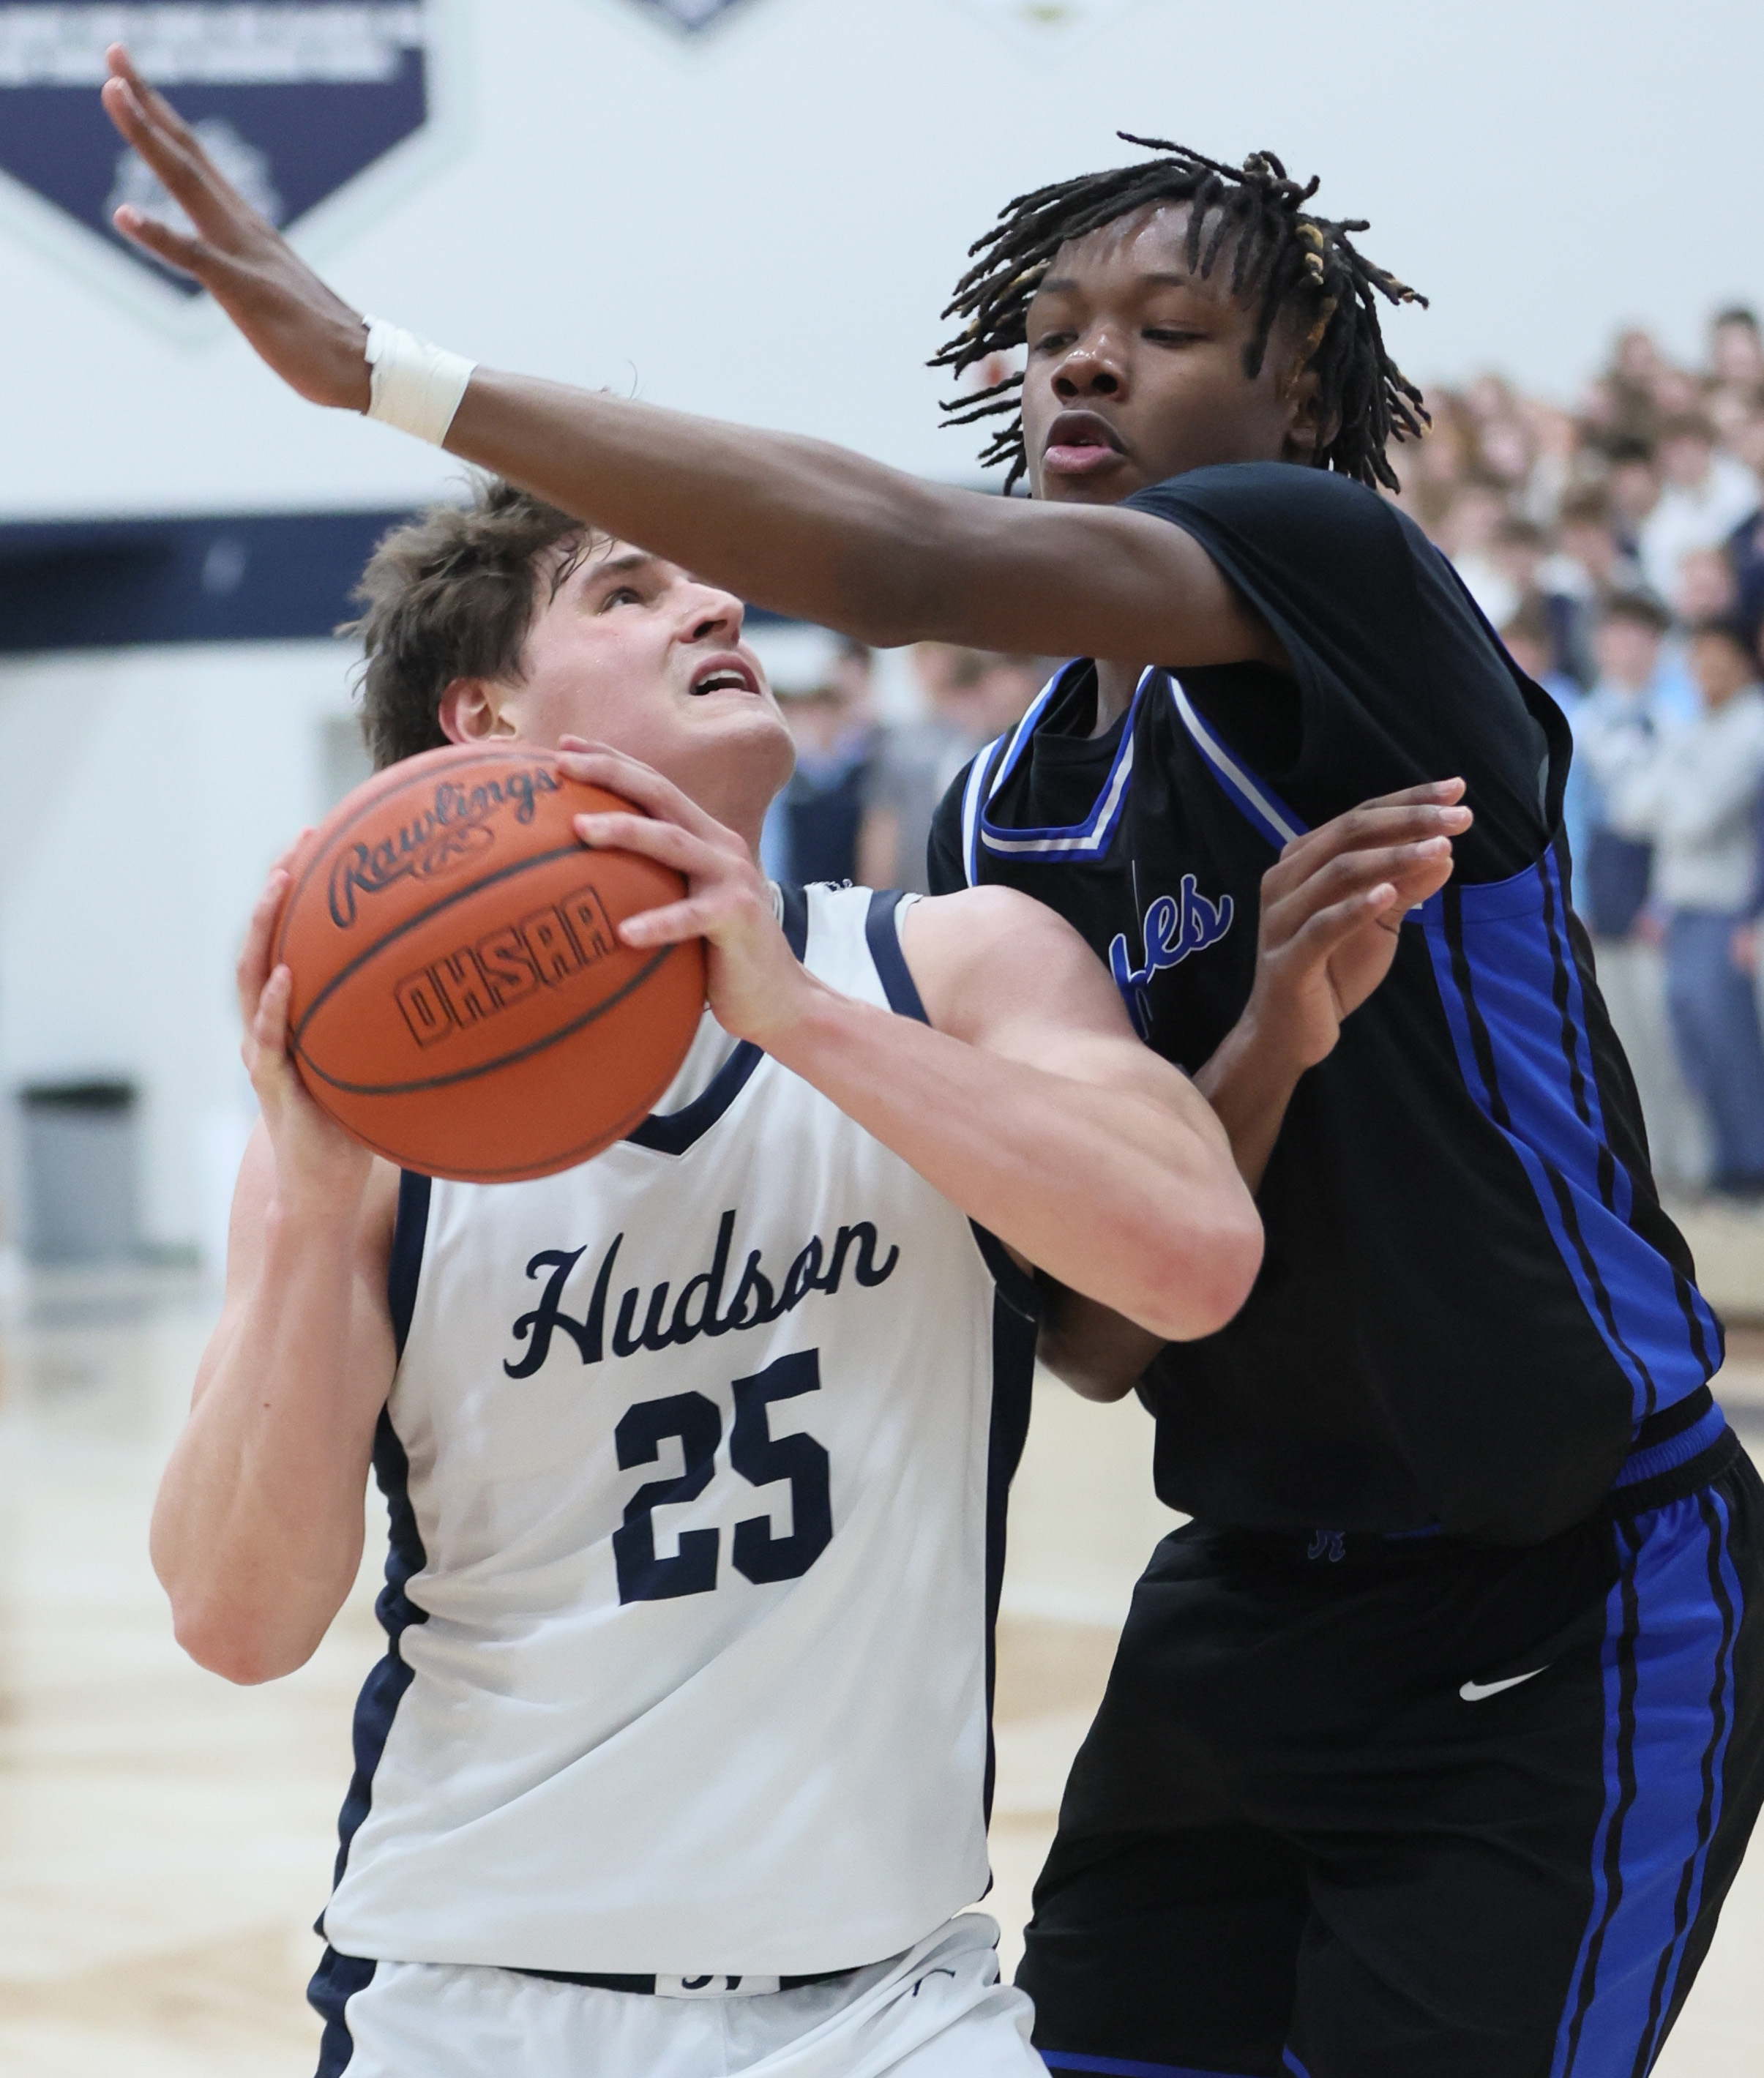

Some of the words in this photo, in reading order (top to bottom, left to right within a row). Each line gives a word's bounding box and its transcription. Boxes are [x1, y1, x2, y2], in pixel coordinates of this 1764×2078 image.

[328, 768, 561, 928] Rawlings
[393, 883, 618, 1048] OHSAA
[504, 1209, 900, 1379] Hudson
[612, 1348, 834, 1607] 25
